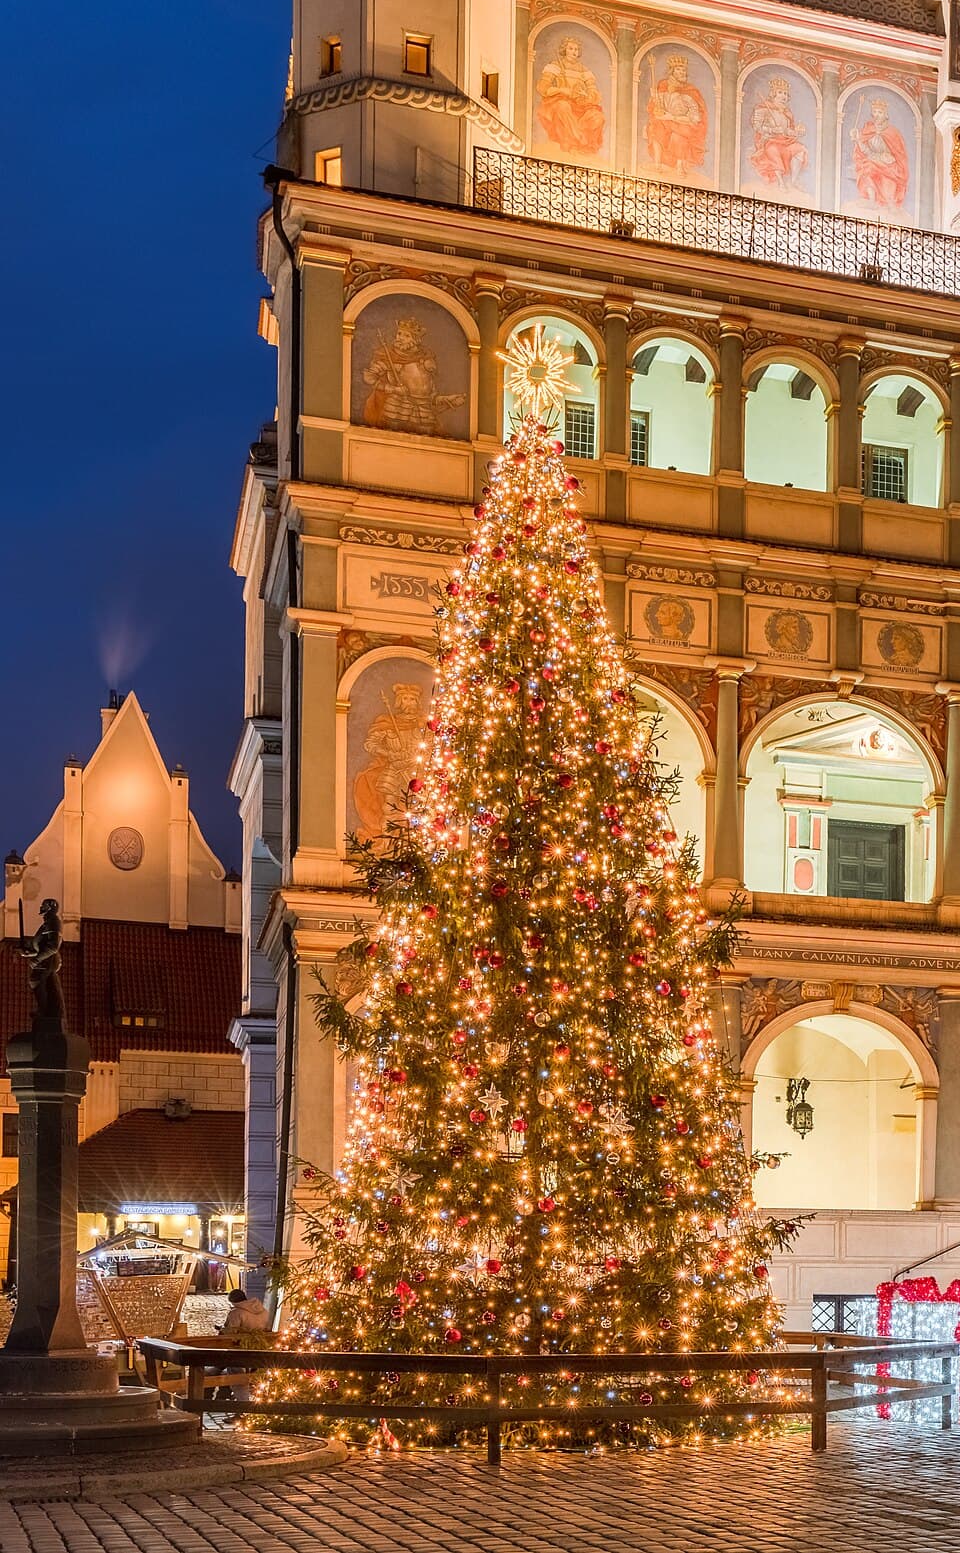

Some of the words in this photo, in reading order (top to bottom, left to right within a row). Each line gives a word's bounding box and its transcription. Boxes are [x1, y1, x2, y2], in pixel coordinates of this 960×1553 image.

[383, 575, 425, 597] 1555
[752, 948, 794, 958] MANV
[802, 951, 899, 965] CALVMNIANTIS
